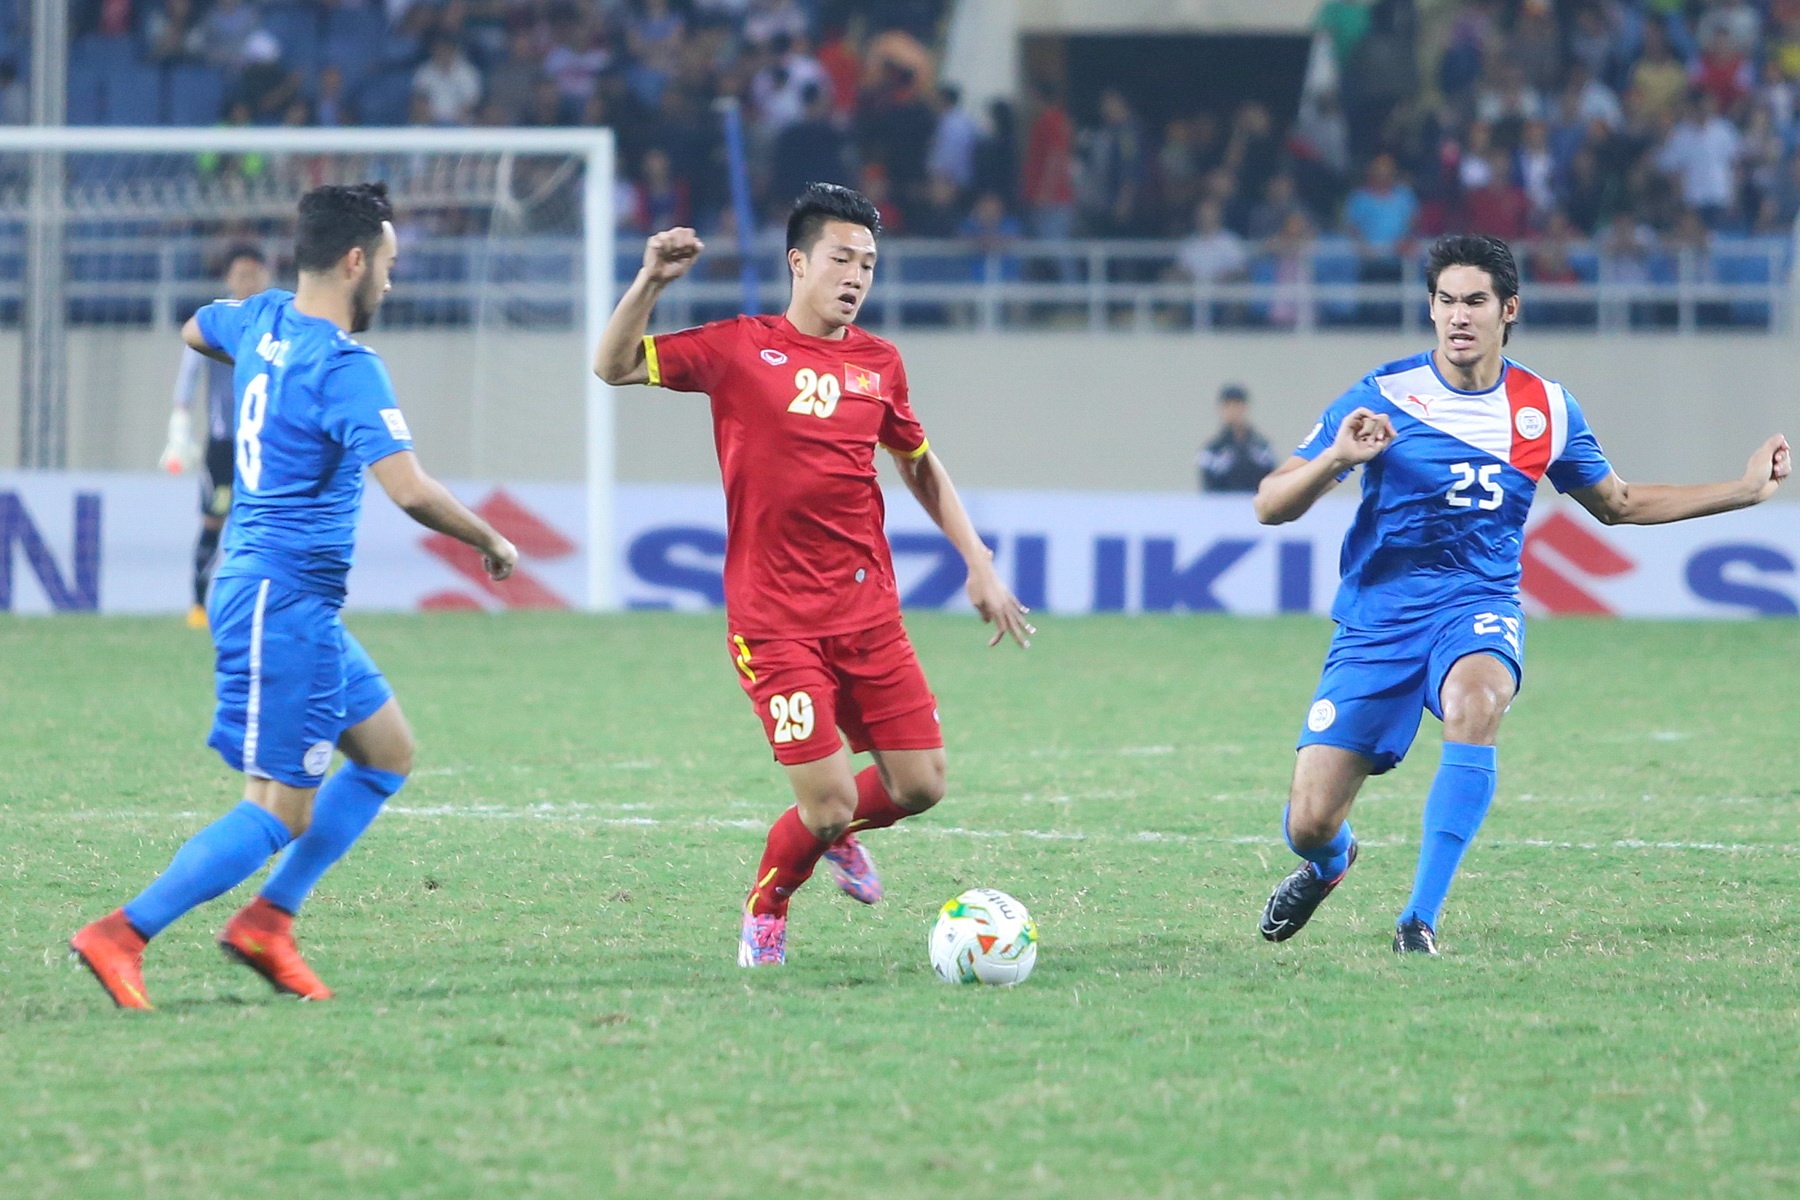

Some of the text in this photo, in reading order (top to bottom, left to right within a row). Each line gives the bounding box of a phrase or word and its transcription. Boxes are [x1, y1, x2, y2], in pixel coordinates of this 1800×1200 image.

[788, 367, 840, 418] 29
[238, 373, 268, 490] 8
[1446, 462, 1503, 510] 25
[628, 526, 1311, 612] SZUKI
[769, 691, 815, 743] 29
